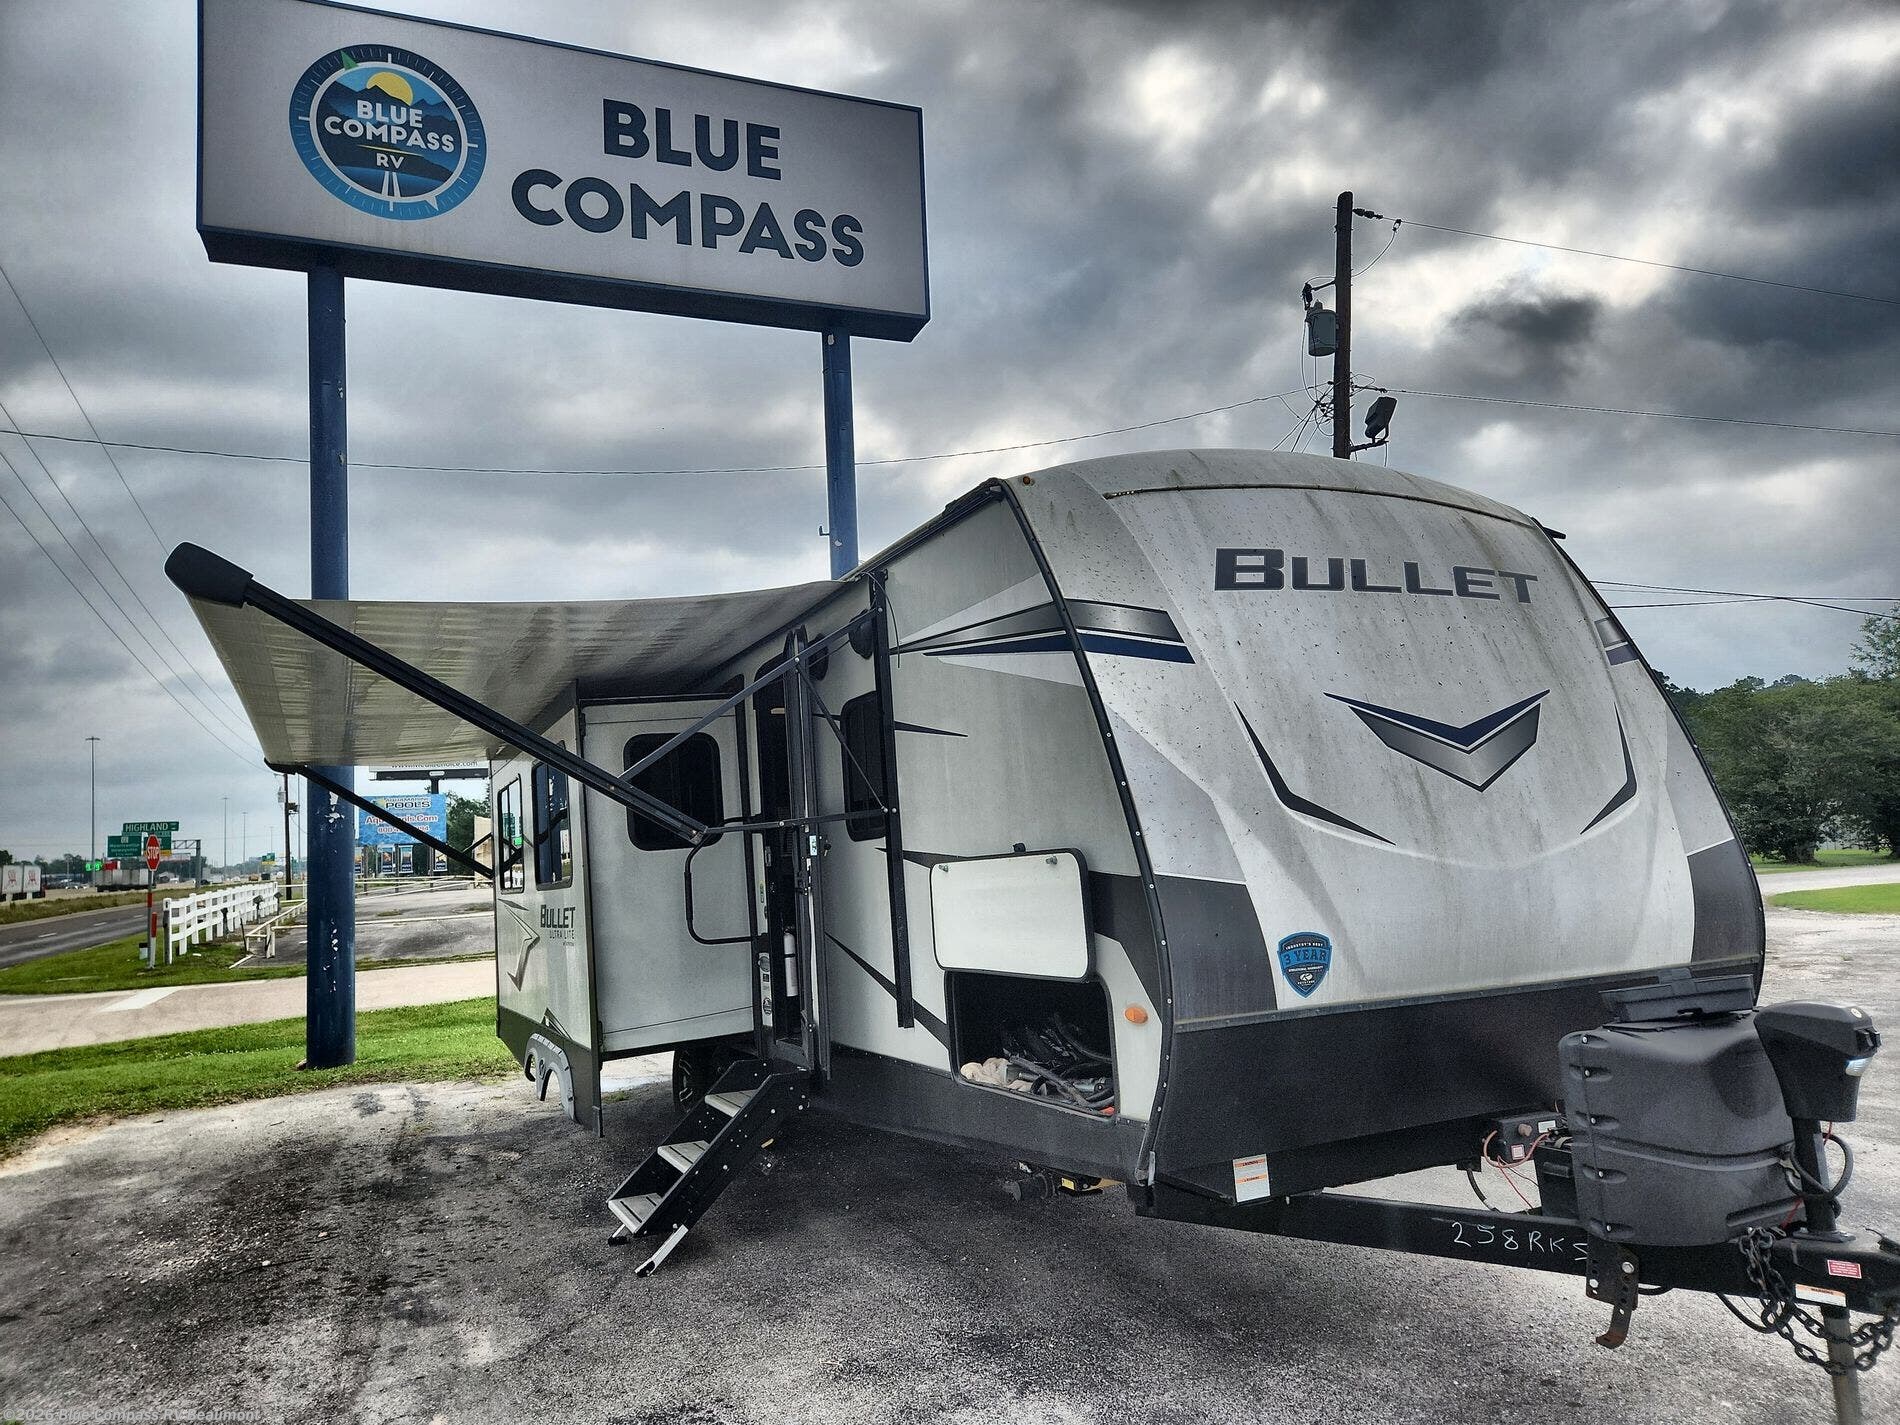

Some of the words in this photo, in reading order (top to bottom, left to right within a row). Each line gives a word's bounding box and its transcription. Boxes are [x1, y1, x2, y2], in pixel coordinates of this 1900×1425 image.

[357, 100, 423, 128] BLUE
[324, 116, 454, 152] COMPASS
[603, 98, 782, 181] BLUE
[376, 152, 404, 169] RV
[511, 168, 864, 268] COMPASS
[1214, 548, 1539, 604] BULLET
[385, 801, 431, 809] POOLS
[125, 822, 169, 832] HIGHLAND
[147, 846, 160, 859] STOP
[540, 904, 576, 929] BULLET
[1283, 953, 1291, 965] 3
[1293, 949, 1327, 962] YEAR
